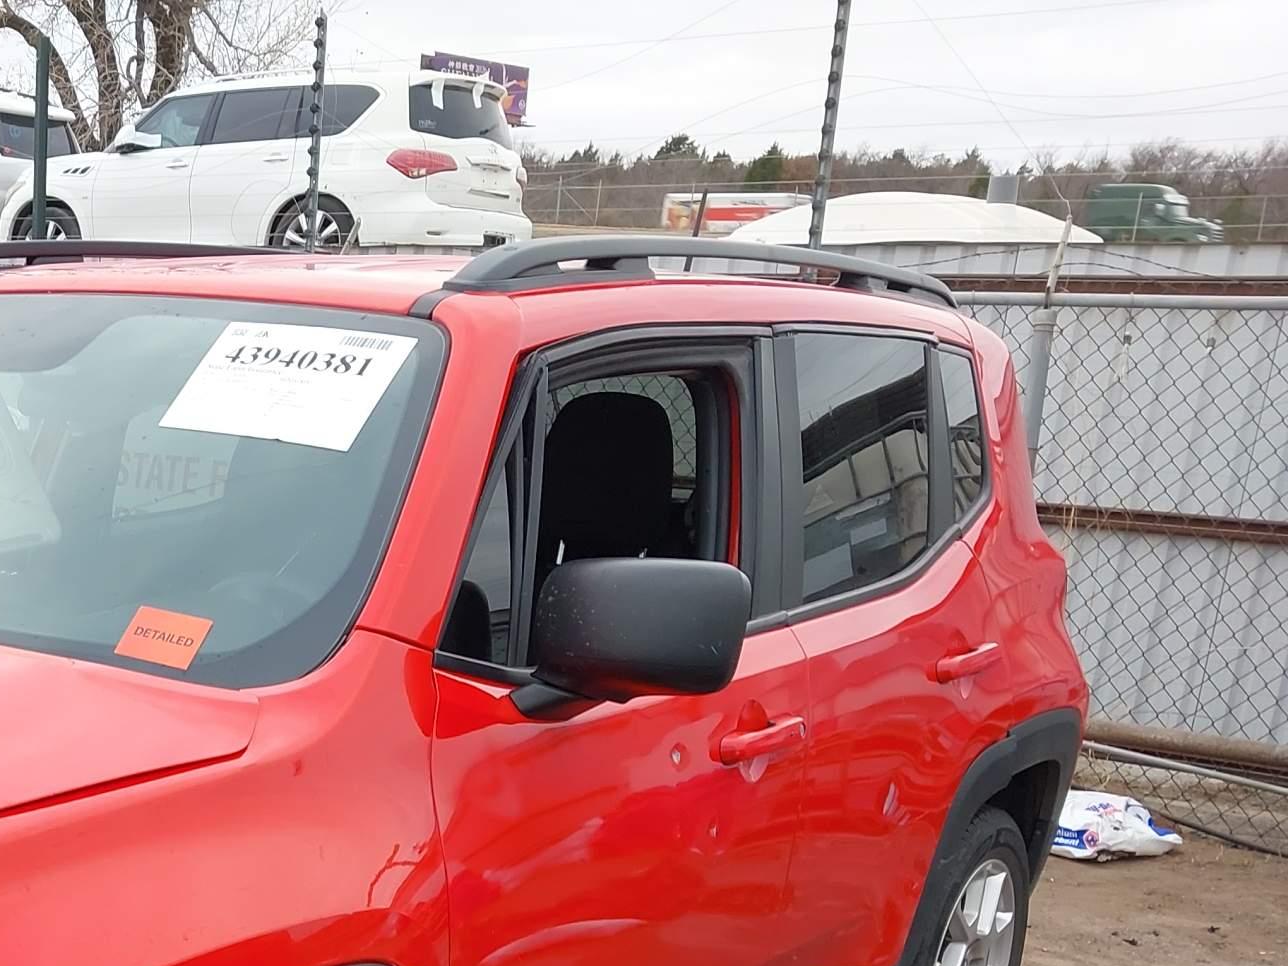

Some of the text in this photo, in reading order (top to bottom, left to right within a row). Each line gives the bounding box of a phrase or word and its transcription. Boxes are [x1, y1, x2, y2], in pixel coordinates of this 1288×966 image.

[225, 344, 374, 377] 43940381
[114, 449, 201, 492] STATE
[133, 626, 195, 648] DETAILED
